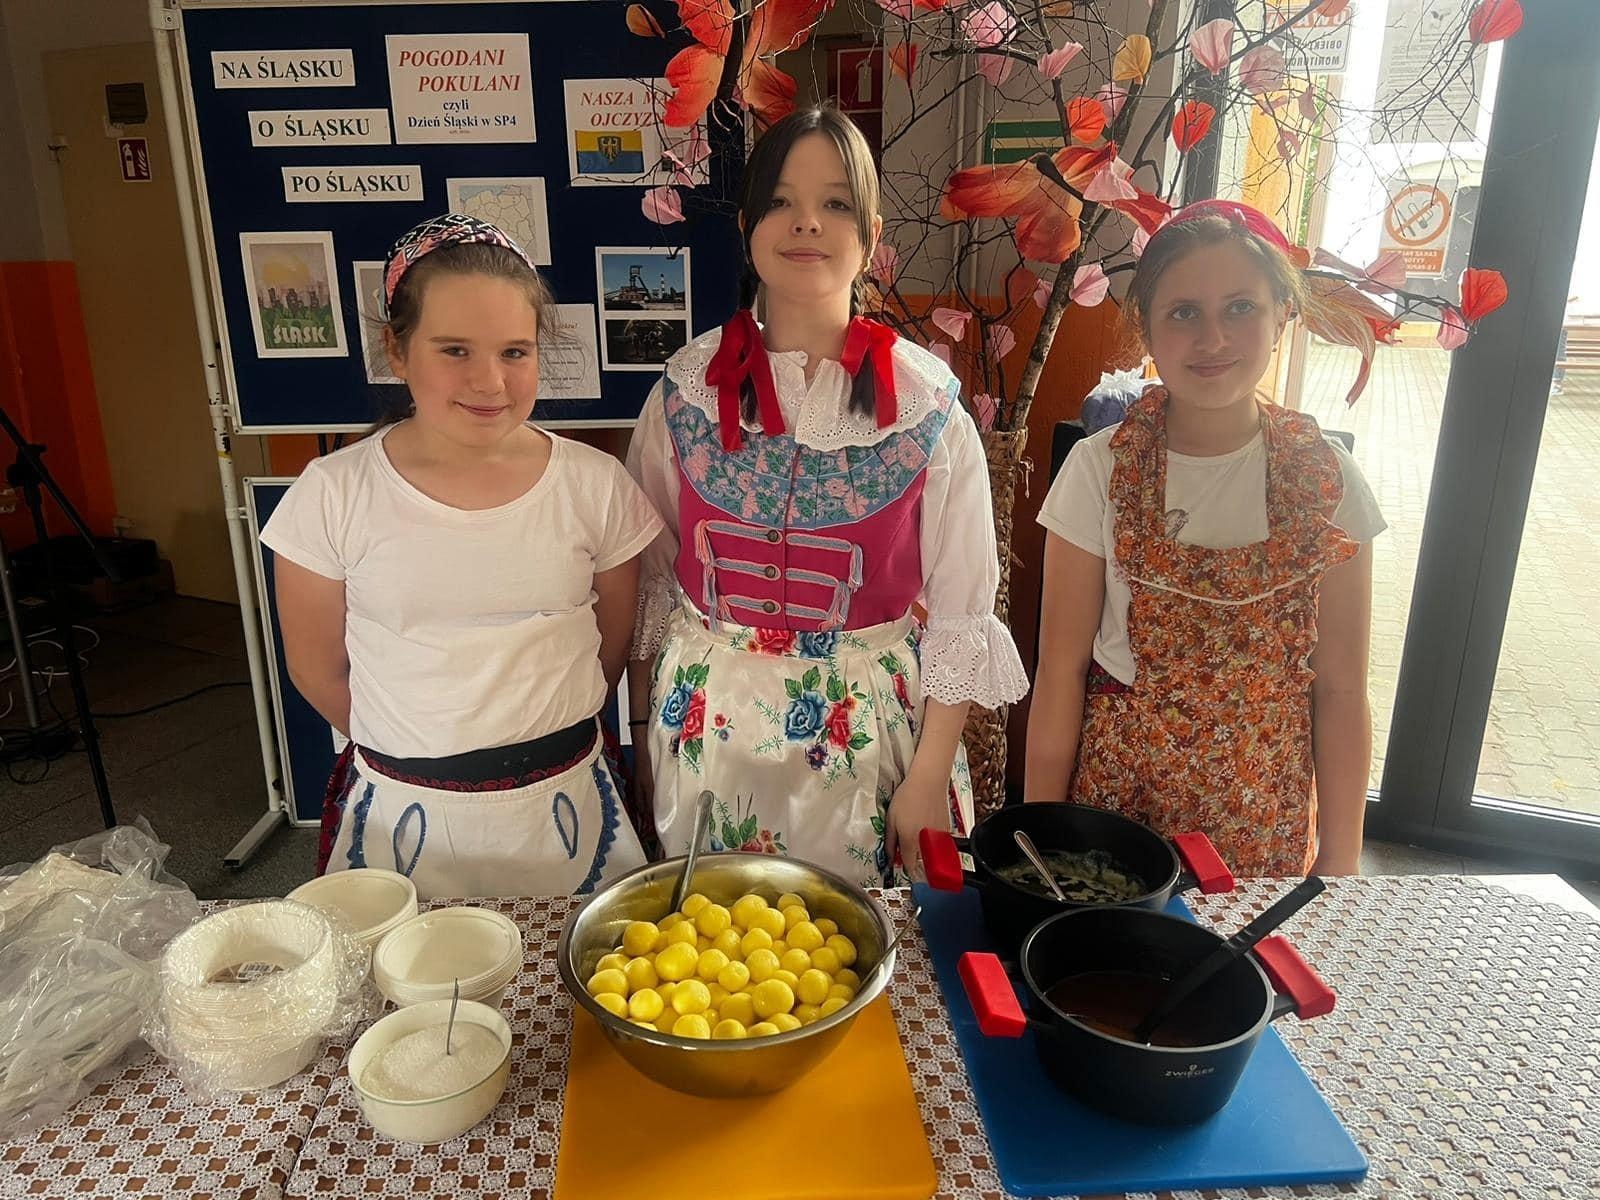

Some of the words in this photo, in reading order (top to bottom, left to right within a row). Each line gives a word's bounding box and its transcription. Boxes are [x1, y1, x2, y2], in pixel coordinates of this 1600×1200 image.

[398, 49, 505, 67] POGODANI
[220, 61, 252, 79] NA
[257, 56, 344, 83] ŚLĄSKU
[418, 74, 521, 92] POKULANI
[443, 99, 469, 113] czyli
[580, 91, 634, 106] NASZA
[257, 119, 275, 138] O
[285, 114, 371, 141] ŚLĄSKU
[407, 115, 440, 128] Dzień
[443, 113, 478, 130] Śląski
[481, 118, 491, 127] w
[494, 115, 517, 127] SP4
[291, 175, 321, 193] PO
[326, 170, 412, 197] ŚLĄSKU
